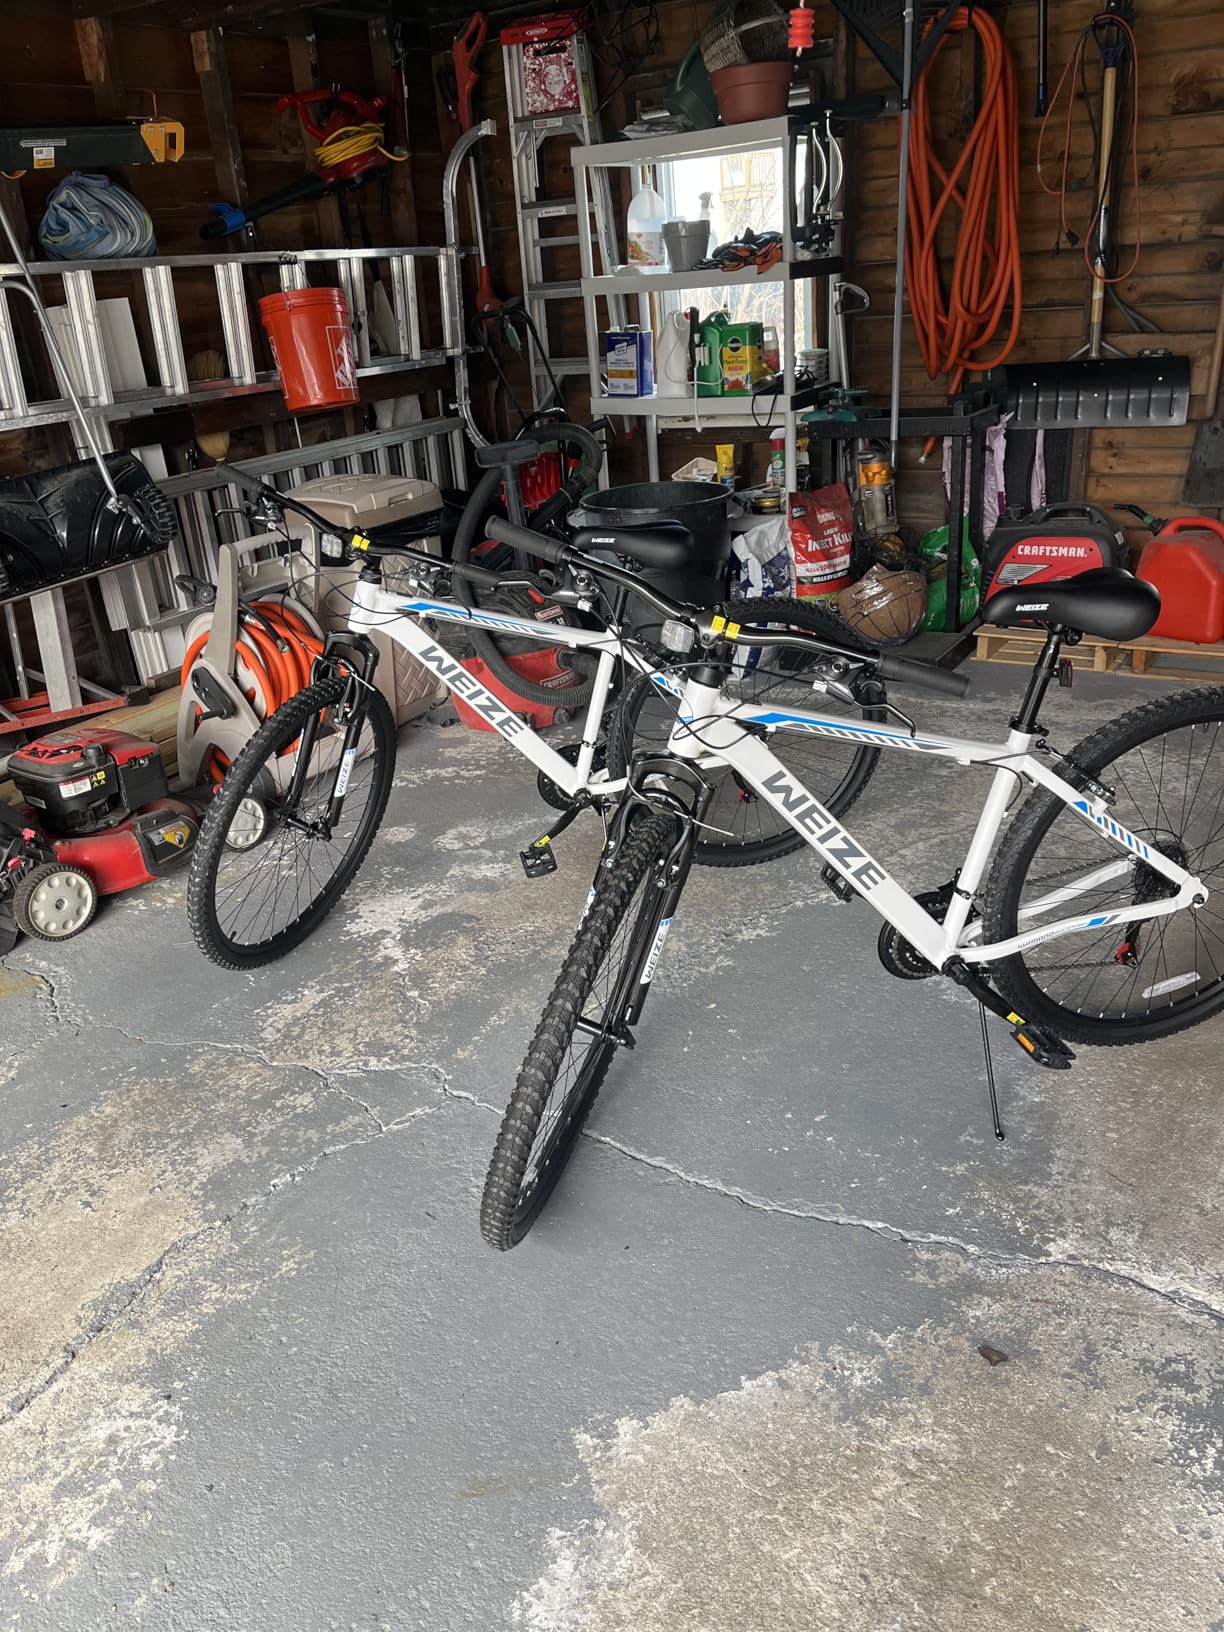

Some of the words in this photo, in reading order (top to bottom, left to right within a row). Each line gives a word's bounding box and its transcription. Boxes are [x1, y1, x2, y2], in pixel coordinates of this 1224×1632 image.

[1017, 544, 1086, 558] CRAFTSMAN
[1015, 603, 1050, 611] WEIZE
[419, 645, 525, 738] WEIZE
[337, 761, 350, 793] WEIZE
[761, 770, 887, 891] WEIZE
[645, 934, 665, 979] WEIZE
